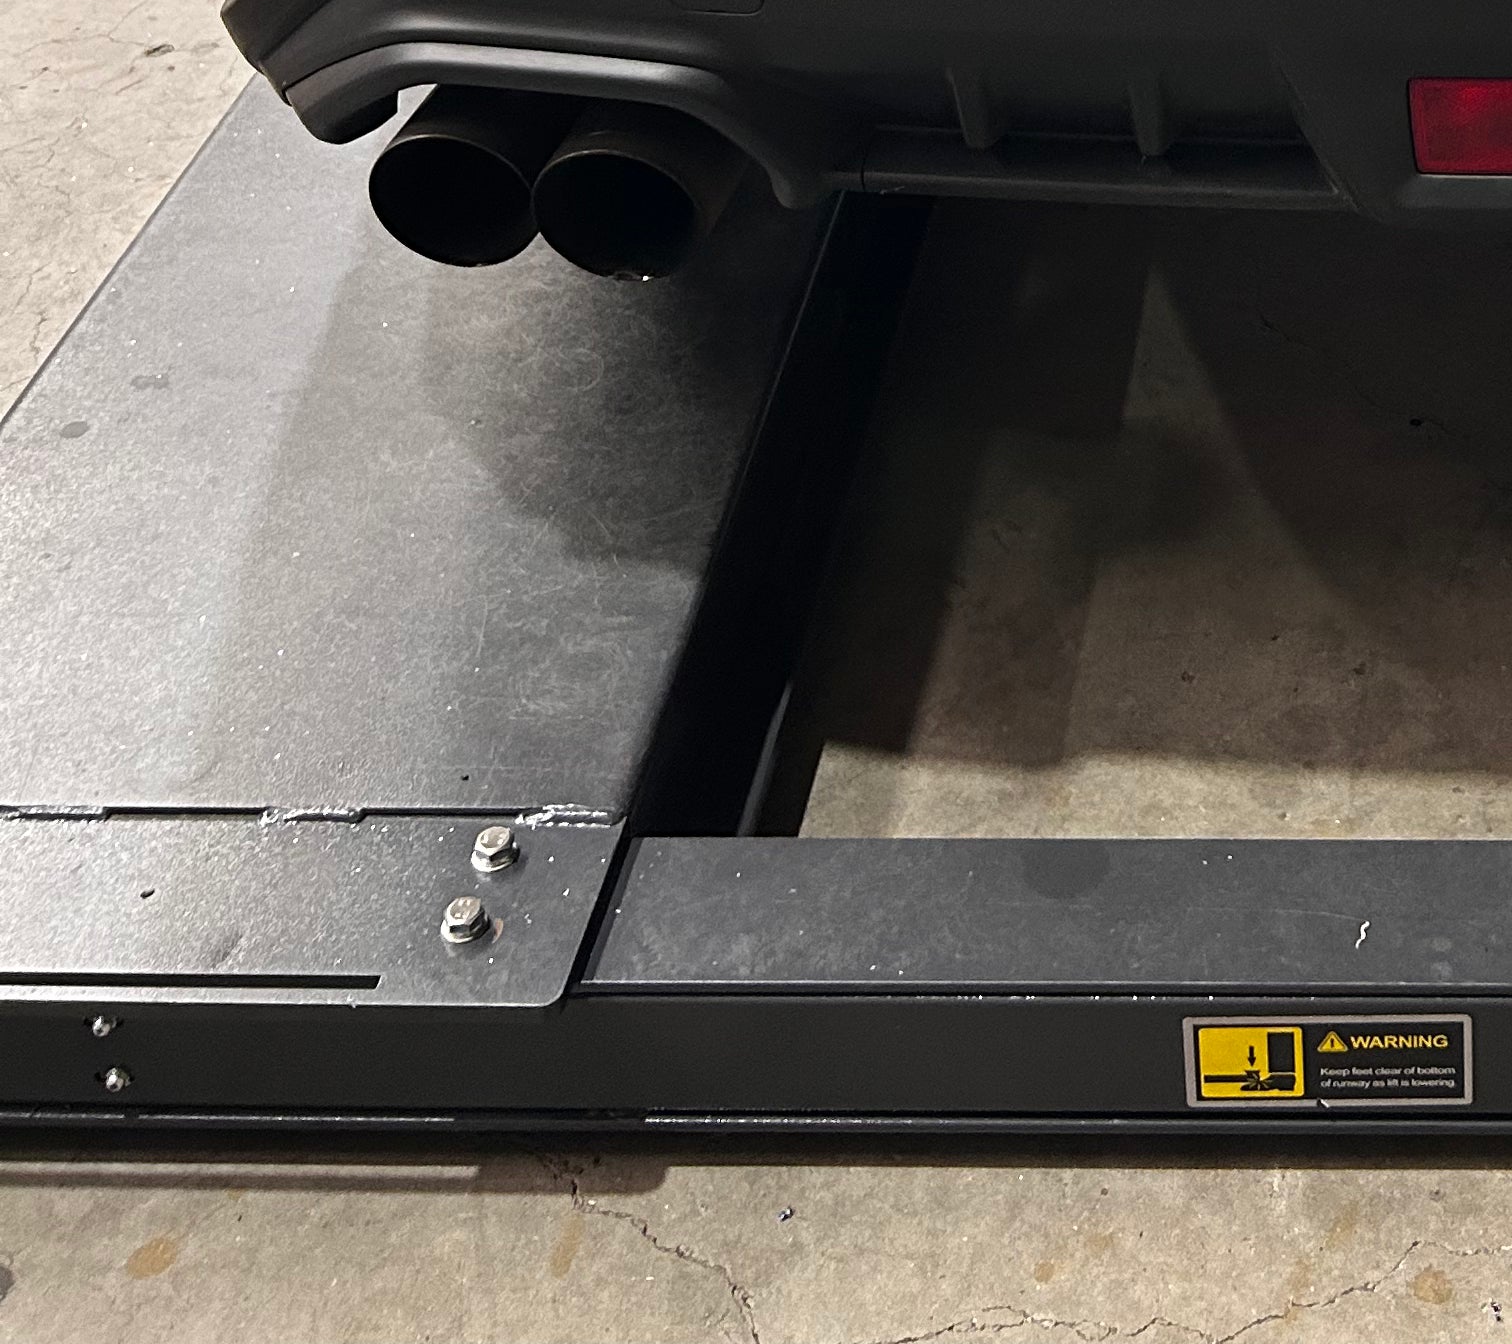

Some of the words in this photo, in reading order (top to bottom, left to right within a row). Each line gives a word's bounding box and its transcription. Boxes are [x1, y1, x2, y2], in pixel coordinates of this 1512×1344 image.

[1350, 1034, 1449, 1049] WARNING
[1320, 1067, 1350, 1077] Keep
[1351, 1067, 1373, 1076] feet
[1374, 1067, 1402, 1076] clear
[1403, 1066, 1415, 1075] of
[1416, 1066, 1456, 1075] bottom
[1320, 1078, 1331, 1088] of
